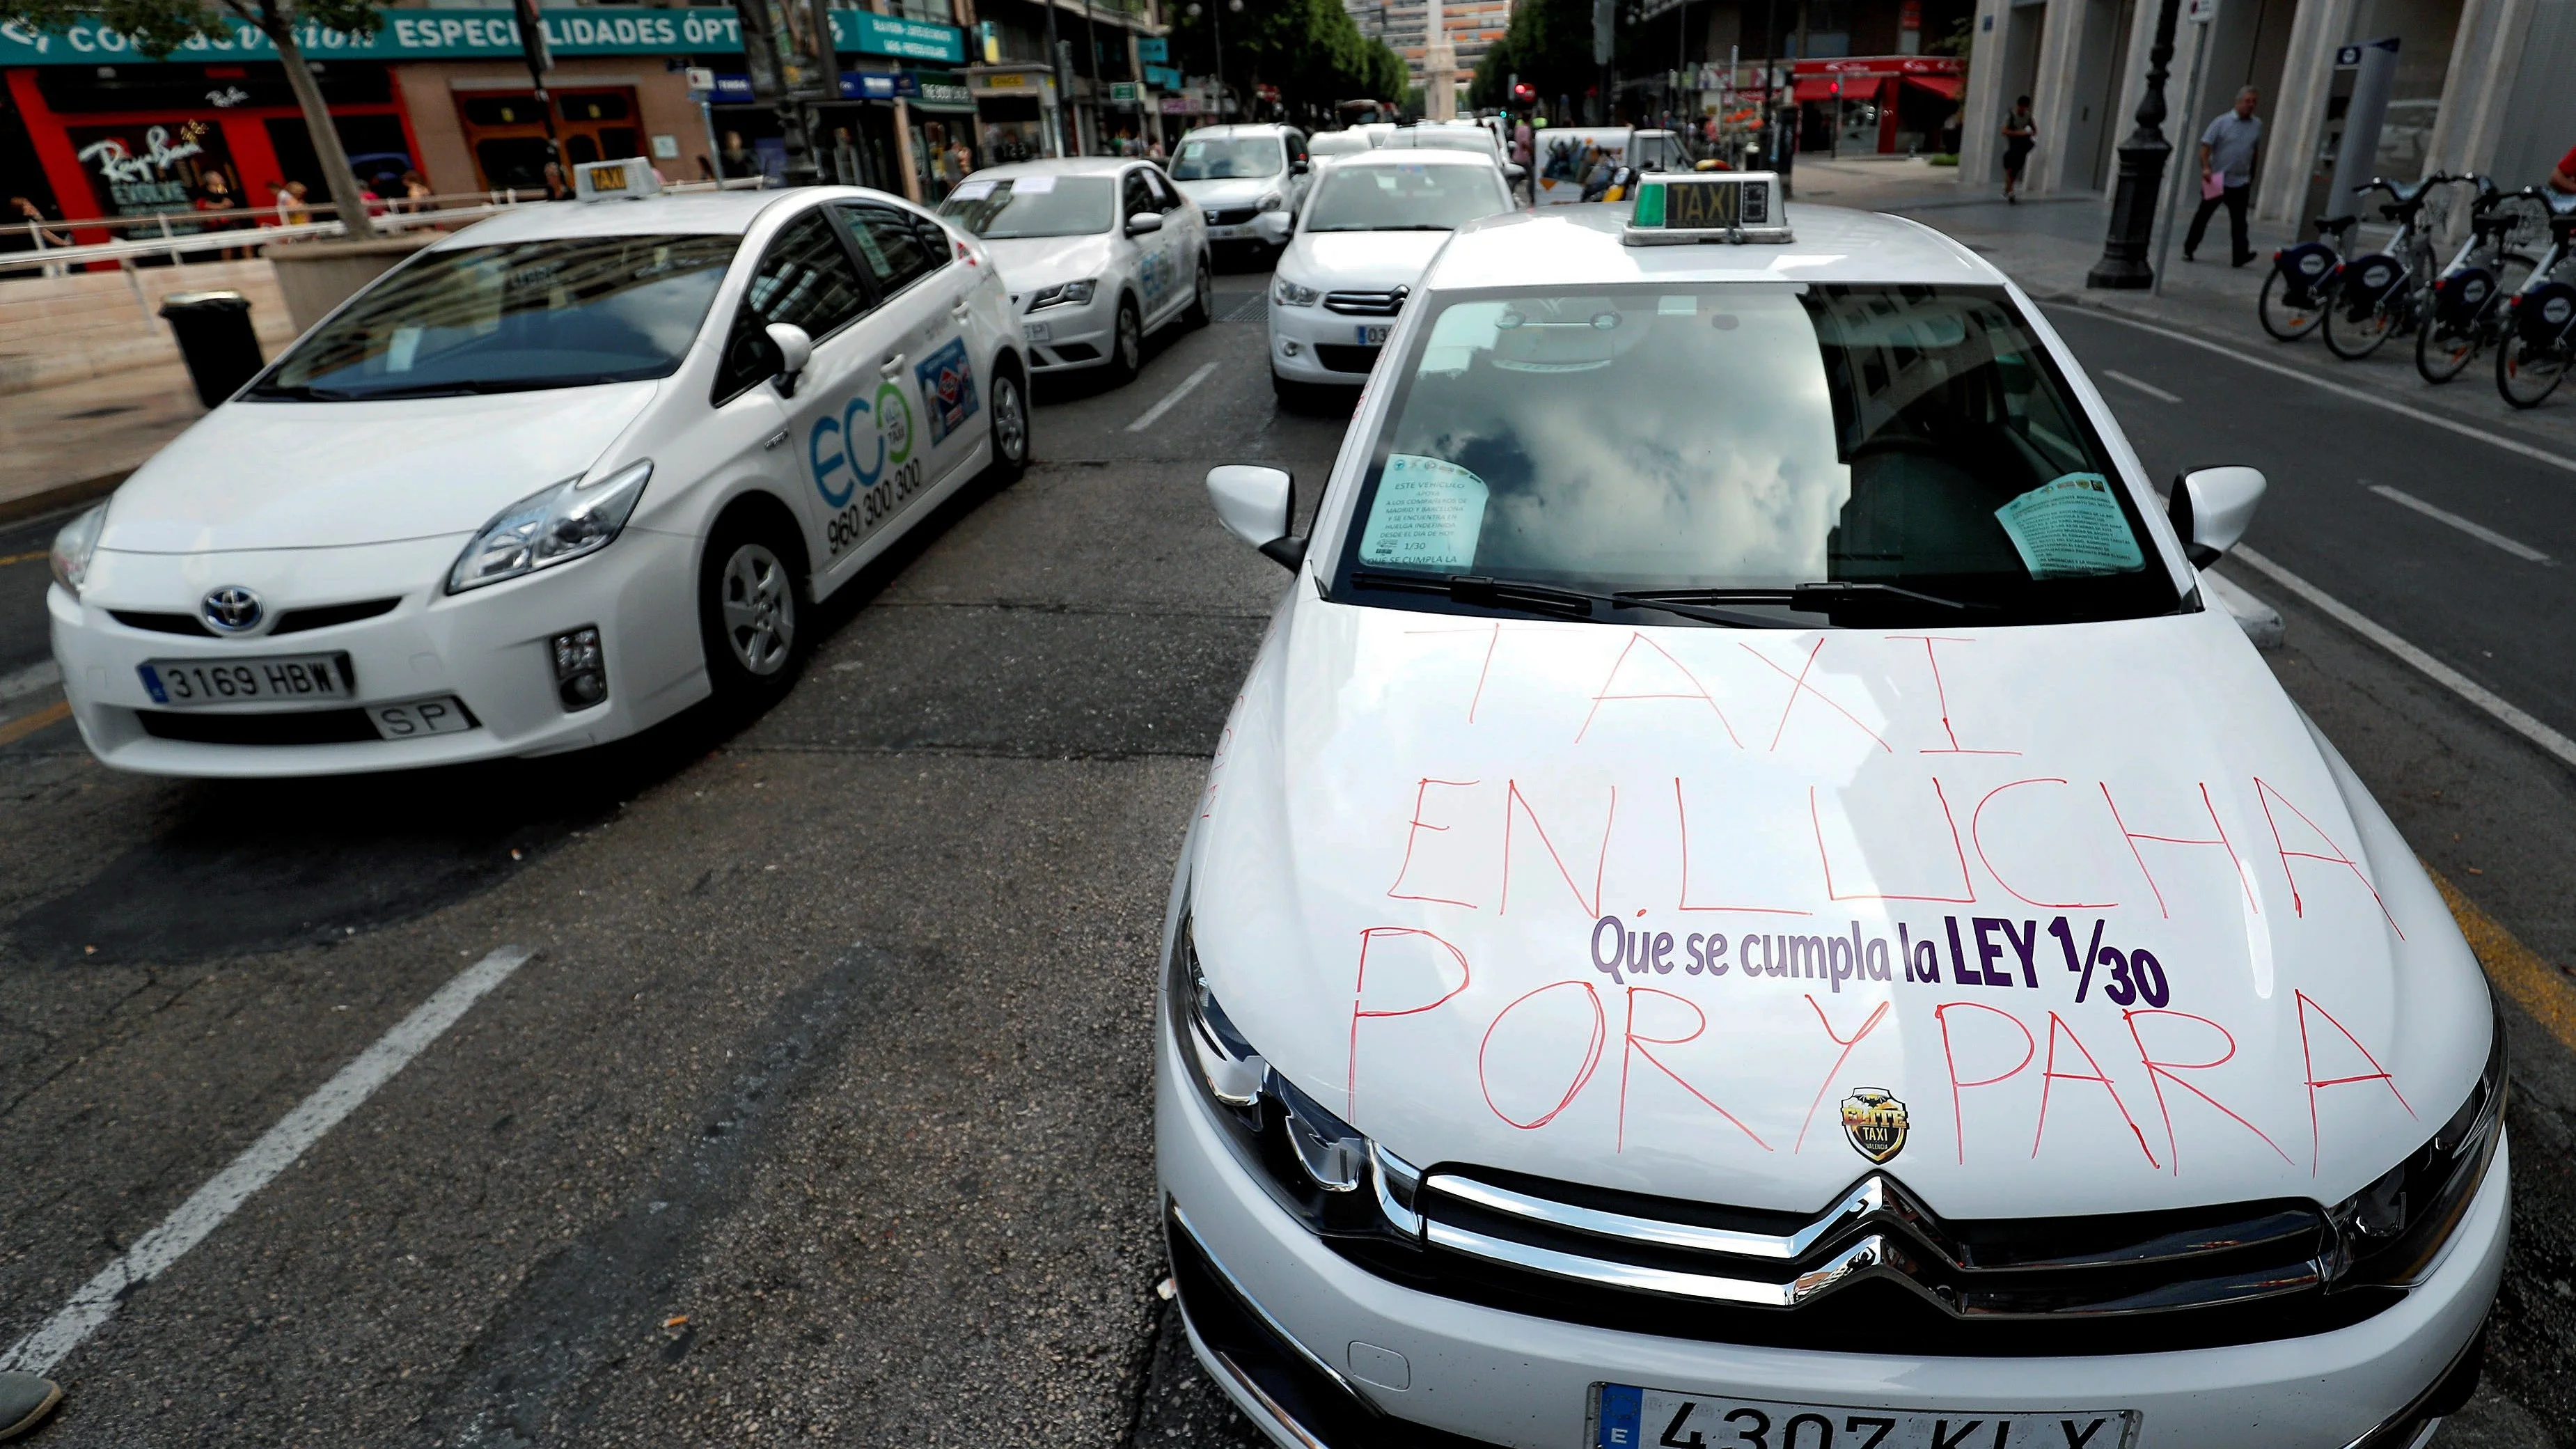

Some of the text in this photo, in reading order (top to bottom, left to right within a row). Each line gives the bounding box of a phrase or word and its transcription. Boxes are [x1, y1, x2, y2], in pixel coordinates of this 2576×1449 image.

[394, 17, 675, 48] ESPECILIDADES
[590, 166, 627, 191] TAXI
[1672, 182, 1736, 221] TAXI
[1367, 327, 1390, 343] 03
[1395, 481, 1415, 489] ESTE
[827, 457, 921, 554] 960 300 300
[1367, 556, 1387, 565] QUE
[1404, 542, 1427, 550] 1/30
[167, 661, 336, 698] 3169 HBW
[1404, 622, 2022, 755] TAXI
[379, 701, 446, 736] SP
[1387, 777, 1617, 920] EN
[1685, 932, 1729, 976] se
[1740, 920, 1893, 994] cumpla
[1897, 922, 1941, 984] la
[1944, 916, 2039, 989] LEY
[2047, 916, 2170, 1008] 1/30
[1348, 926, 2420, 1179] POR Y PARA
[1841, 1107, 1908, 1129] ELITE
[1862, 1127, 1889, 1142] TAXI
[1610, 1427, 1628, 1444] E
